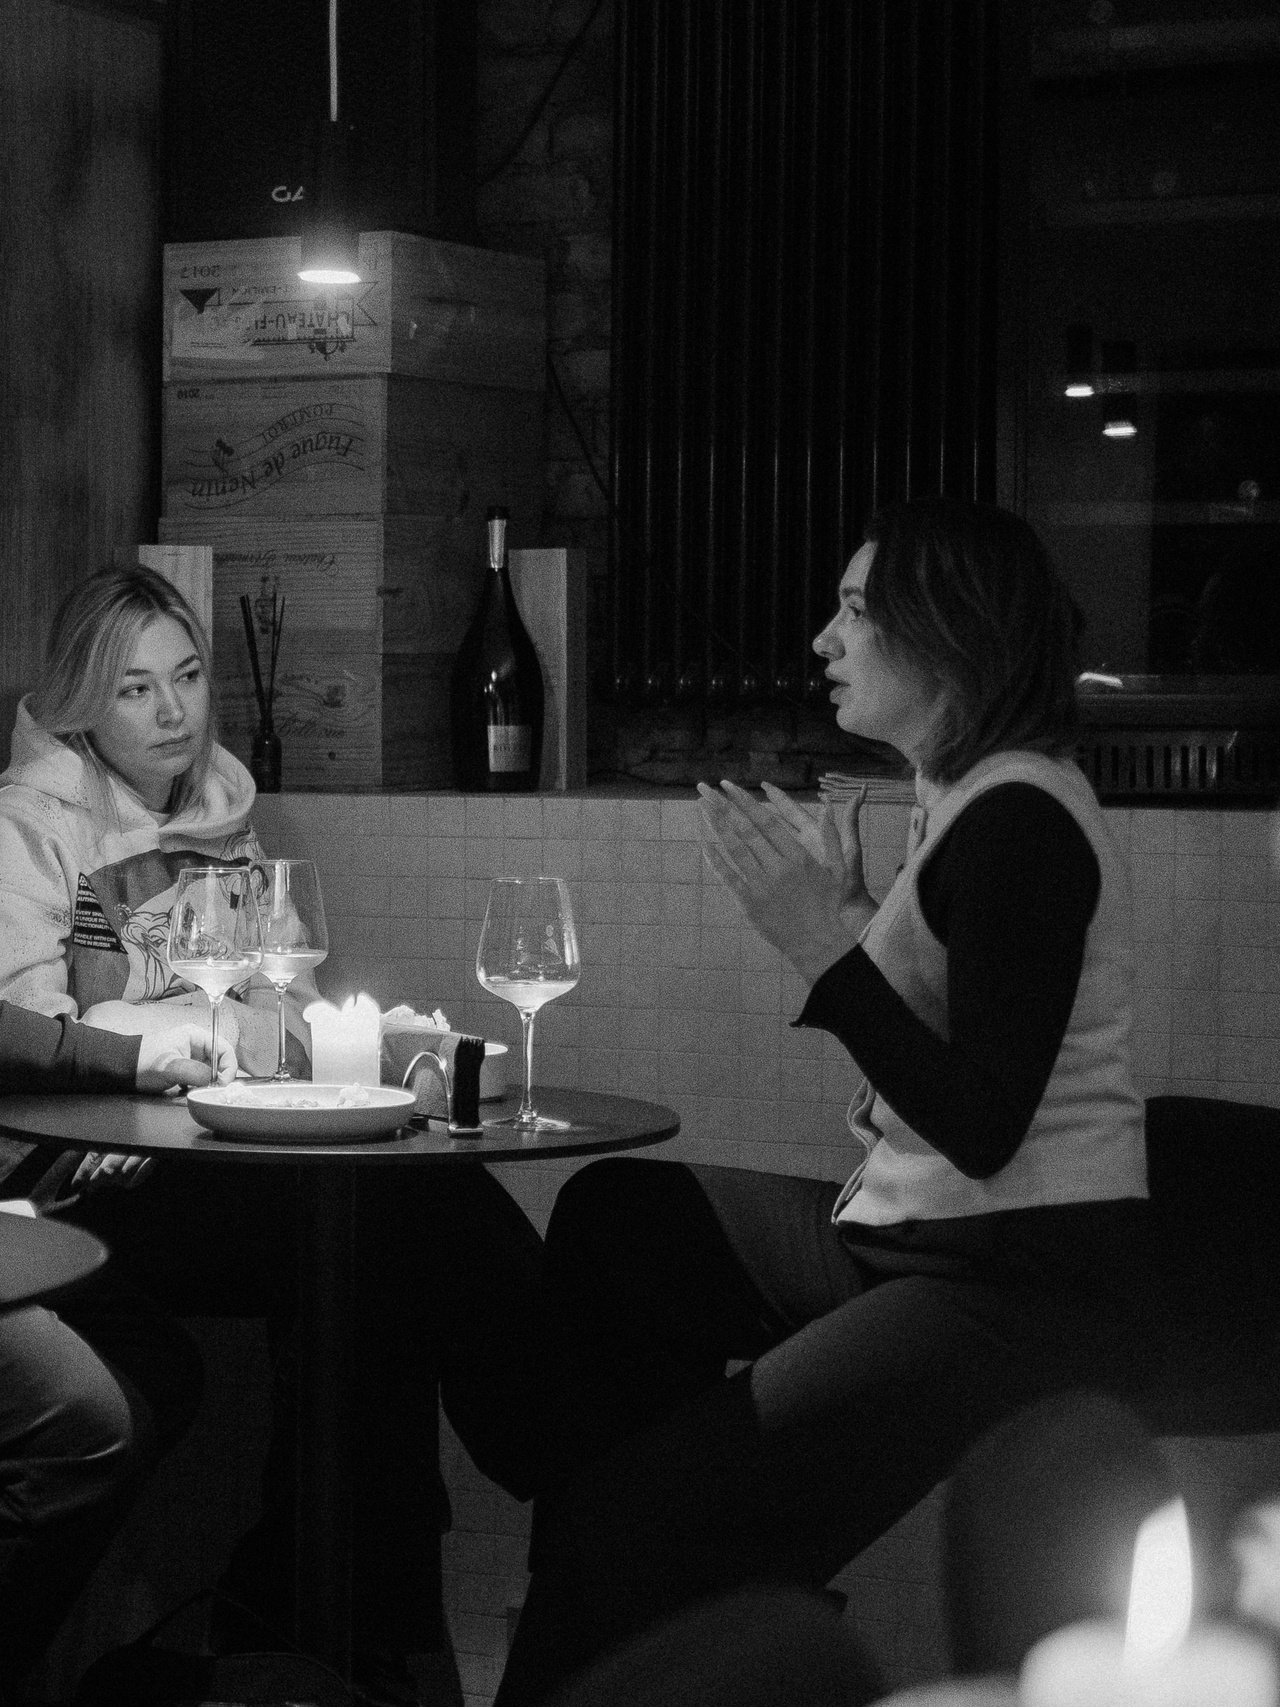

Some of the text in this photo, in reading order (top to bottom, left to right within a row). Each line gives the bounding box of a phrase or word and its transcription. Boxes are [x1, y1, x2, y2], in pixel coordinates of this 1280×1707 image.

[180, 264, 221, 279] 2017
[190, 430, 355, 501] Fugue de Nenin
